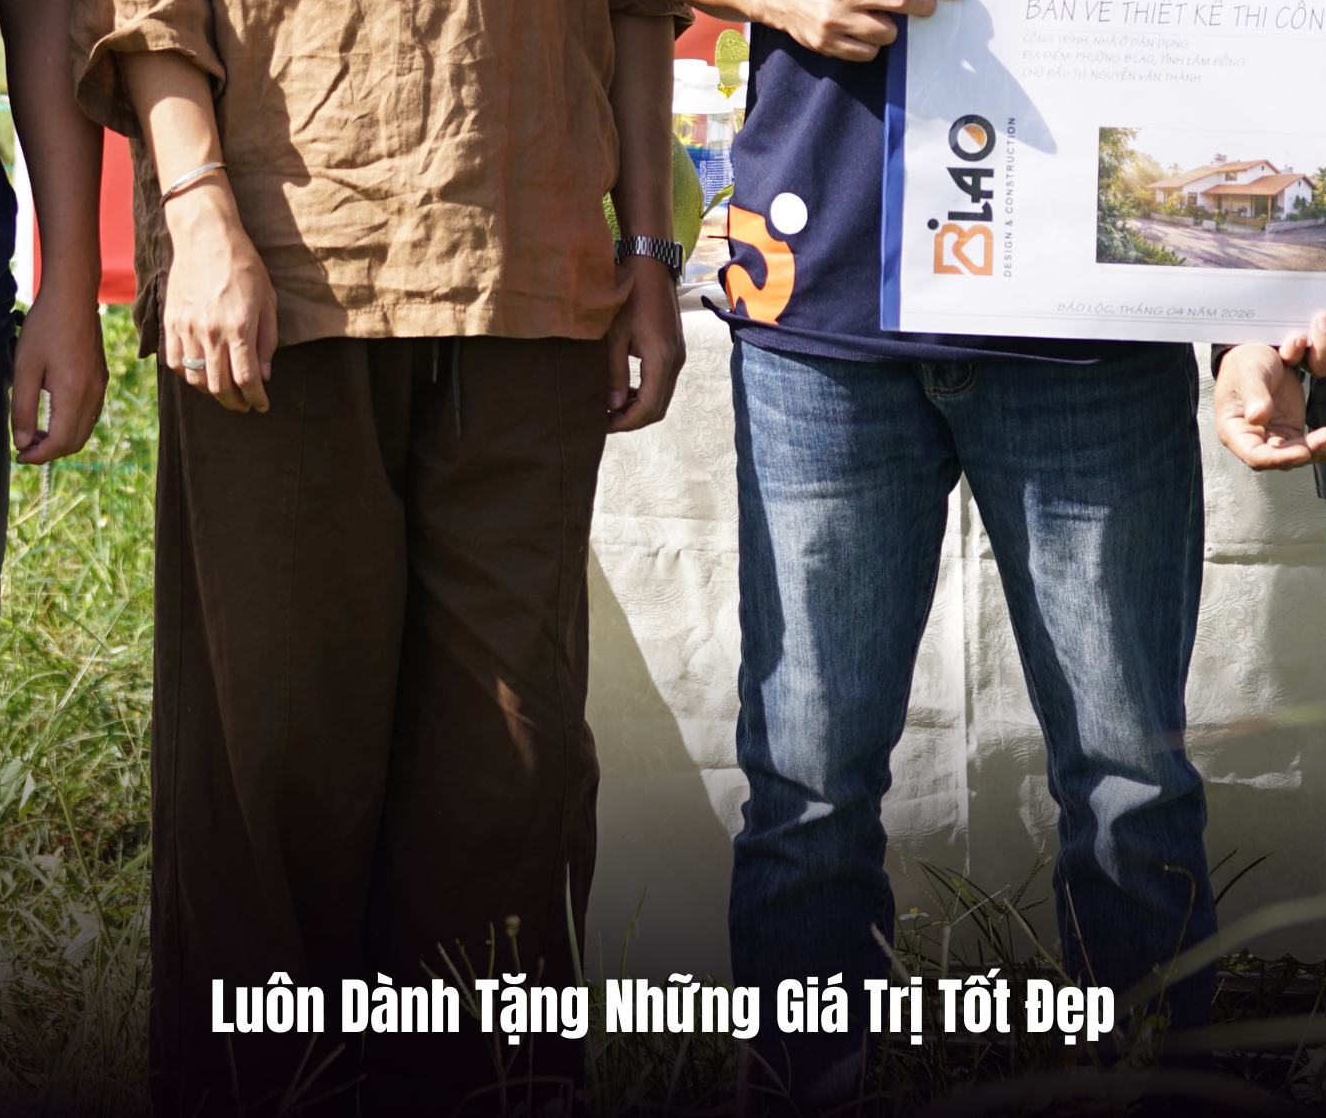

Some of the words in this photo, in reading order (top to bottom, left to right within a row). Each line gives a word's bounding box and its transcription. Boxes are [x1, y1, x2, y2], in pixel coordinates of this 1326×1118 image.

[1233, 5, 1268, 28] THI
[1005, 117, 1016, 214] CONSTRUCTION
[1005, 219, 1013, 227] &
[1004, 232, 1013, 278] DESIGN
[1119, 305, 1164, 316] THÁNG
[1167, 307, 1184, 316] 04
[1188, 307, 1217, 318] NĂM
[1220, 309, 1256, 319] 2026
